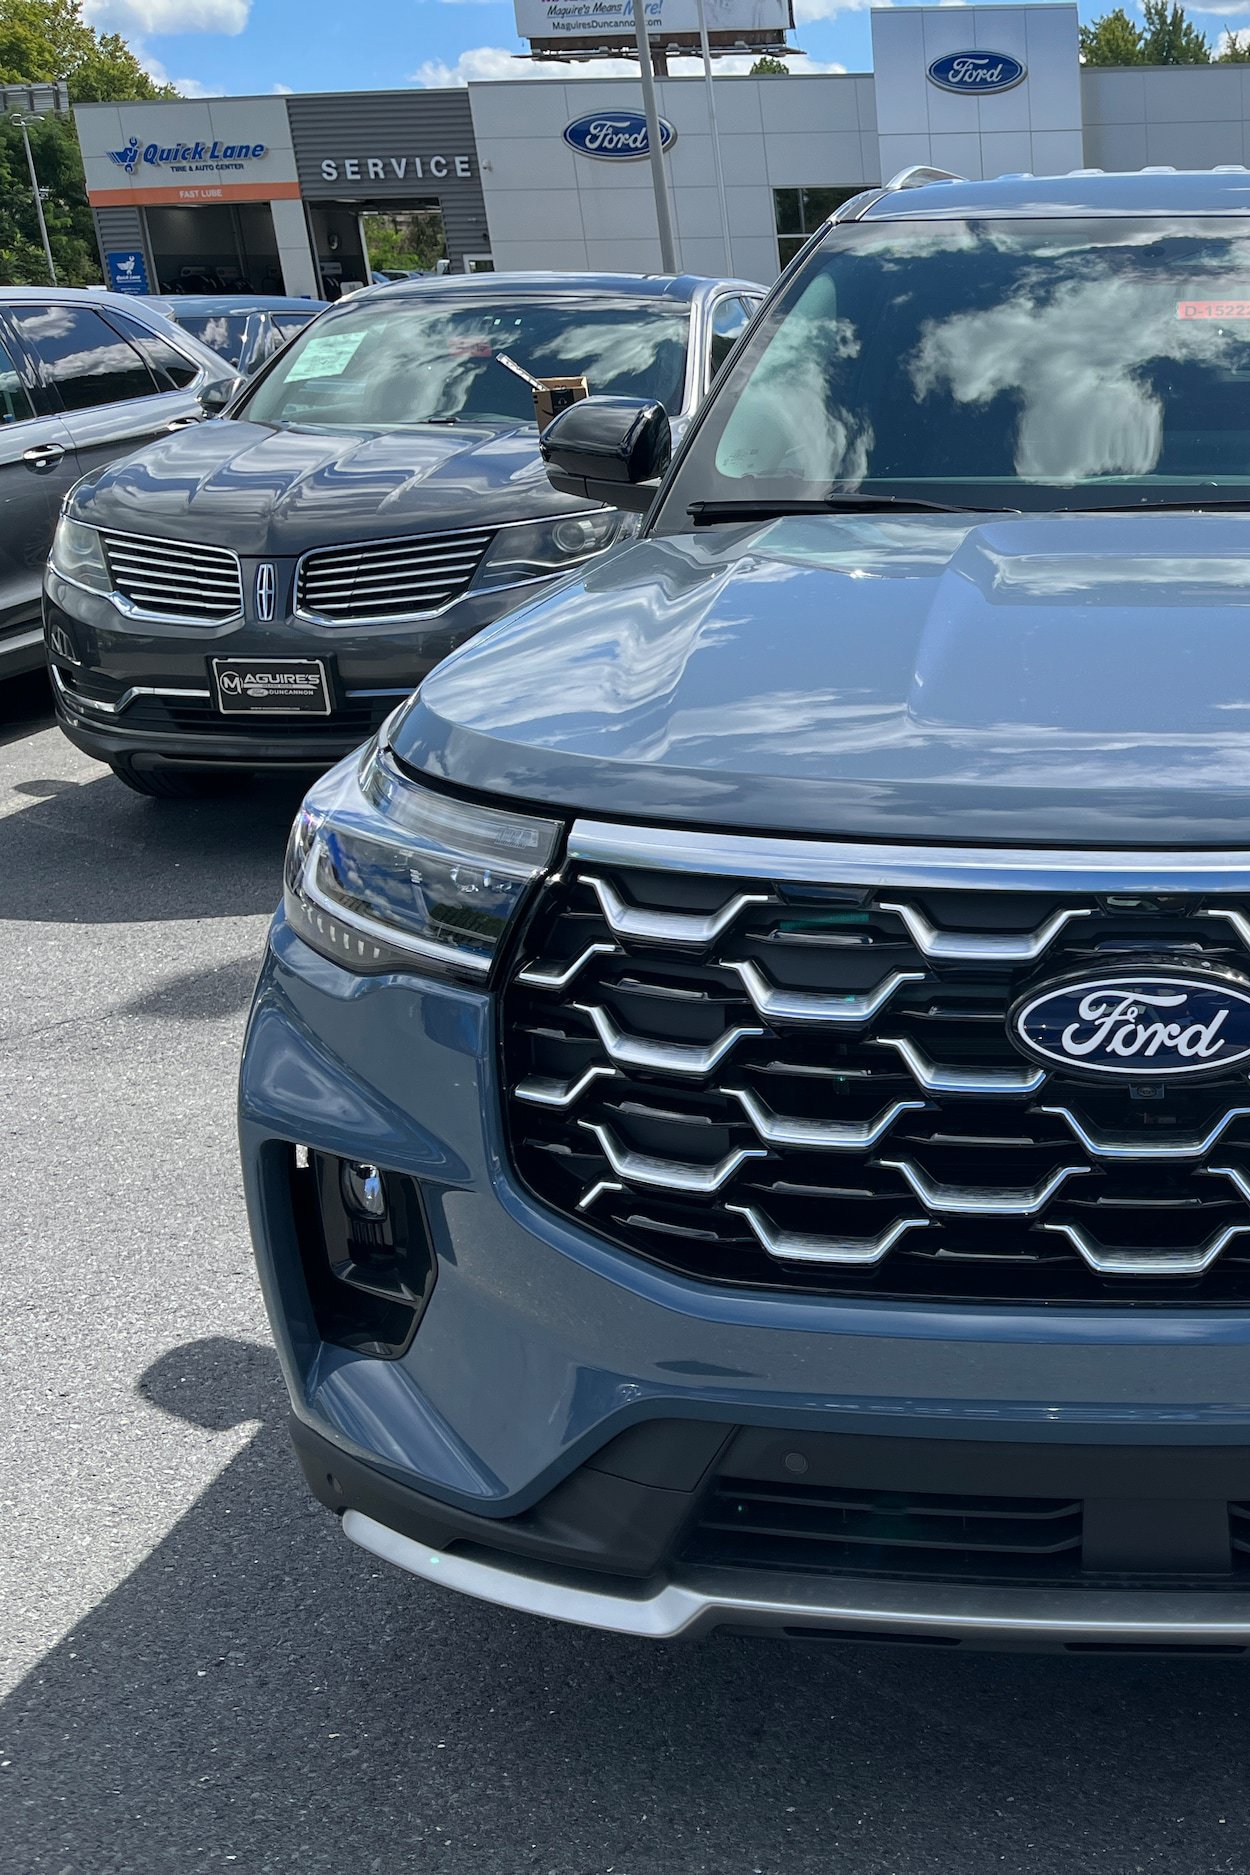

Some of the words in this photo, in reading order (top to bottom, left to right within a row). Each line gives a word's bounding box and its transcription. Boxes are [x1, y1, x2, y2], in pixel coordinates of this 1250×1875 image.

[547, 4, 590, 19] Maguire's
[592, 2, 623, 14] Means
[623, 0, 663, 16] Mre!
[552, 19, 662, 31] MaguiresDuncannoom
[948, 57, 1003, 83] Ford
[584, 120, 648, 149] Ford
[143, 142, 205, 165] Quick
[209, 141, 265, 160] Lane
[195, 163, 214, 171] AUTO
[321, 156, 471, 181] SERVICE
[1061, 989, 1229, 1058] Ford
